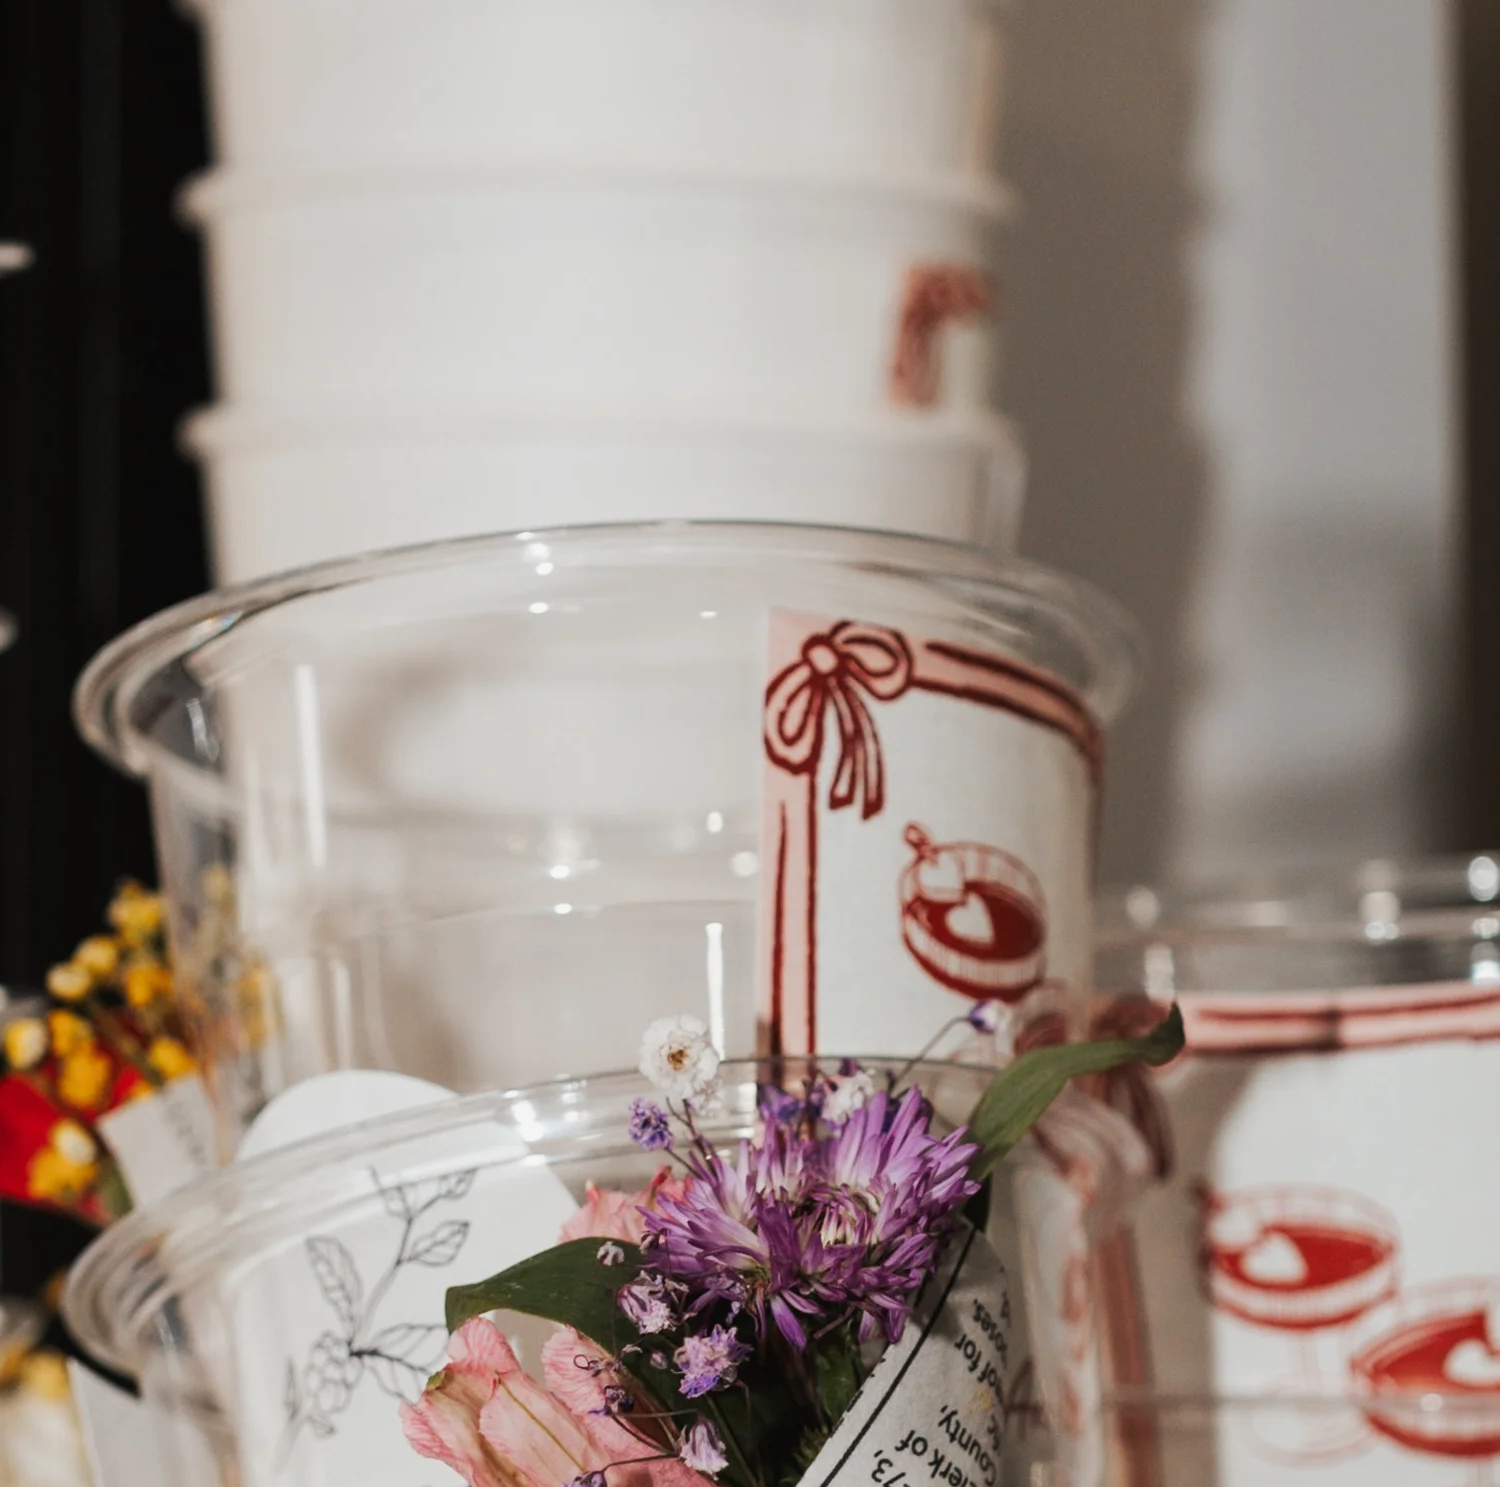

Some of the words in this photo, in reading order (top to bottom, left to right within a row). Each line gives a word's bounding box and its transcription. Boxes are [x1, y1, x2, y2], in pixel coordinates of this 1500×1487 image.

[955, 1334, 982, 1372] for
[895, 1430, 928, 1456] of
[938, 1405, 996, 1487] County,
